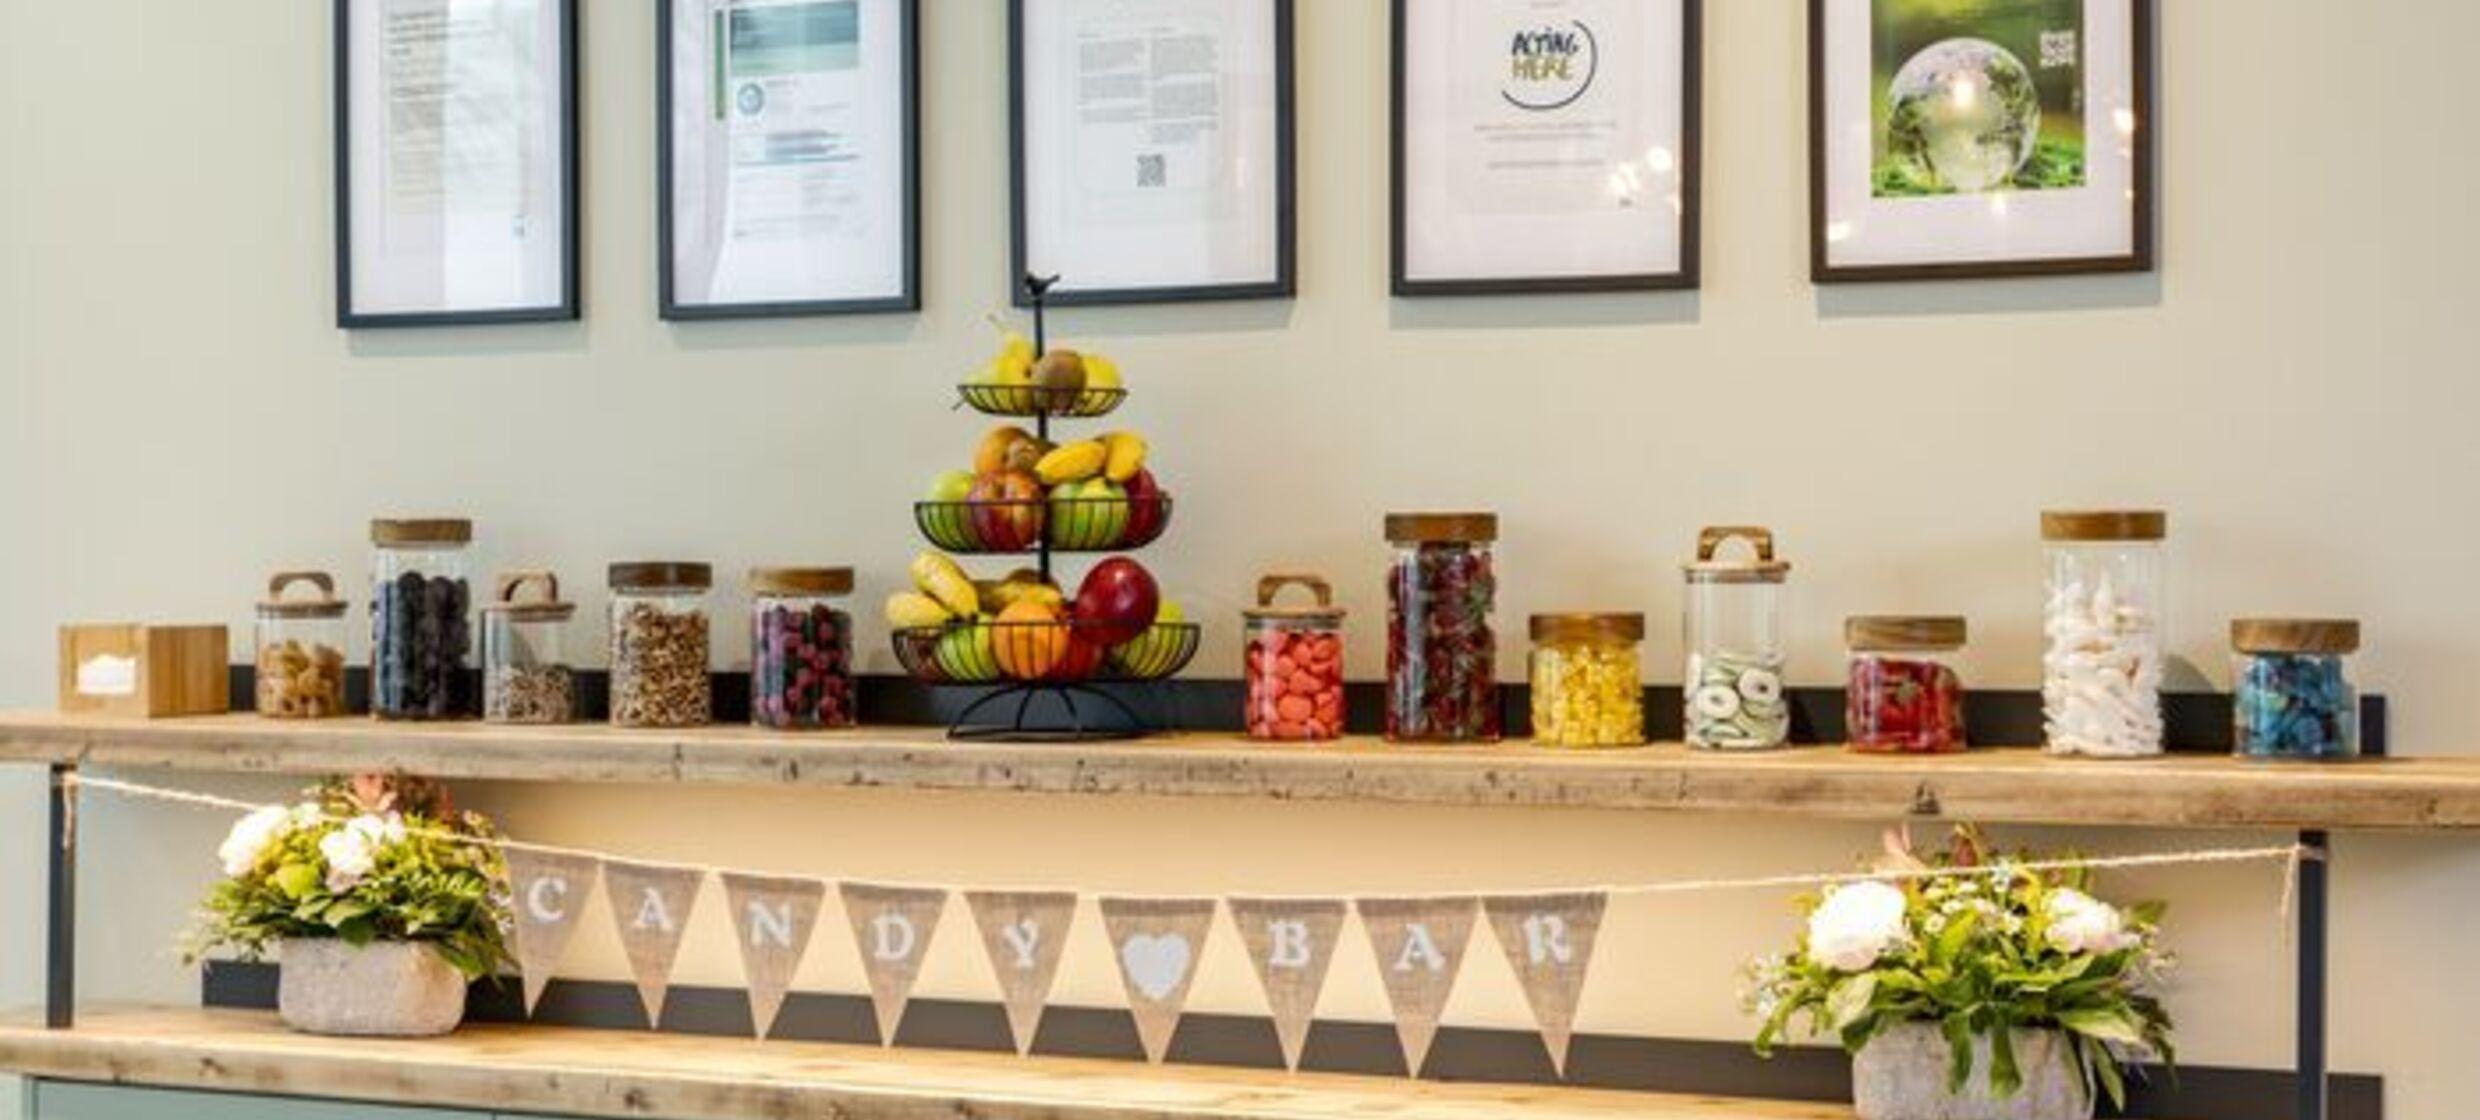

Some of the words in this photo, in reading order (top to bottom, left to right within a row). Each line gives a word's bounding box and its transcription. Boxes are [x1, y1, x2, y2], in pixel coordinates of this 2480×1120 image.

[1511, 57, 1574, 81] HERE
[527, 875, 1041, 968] CANDY
[1267, 911, 1573, 972] BAR
